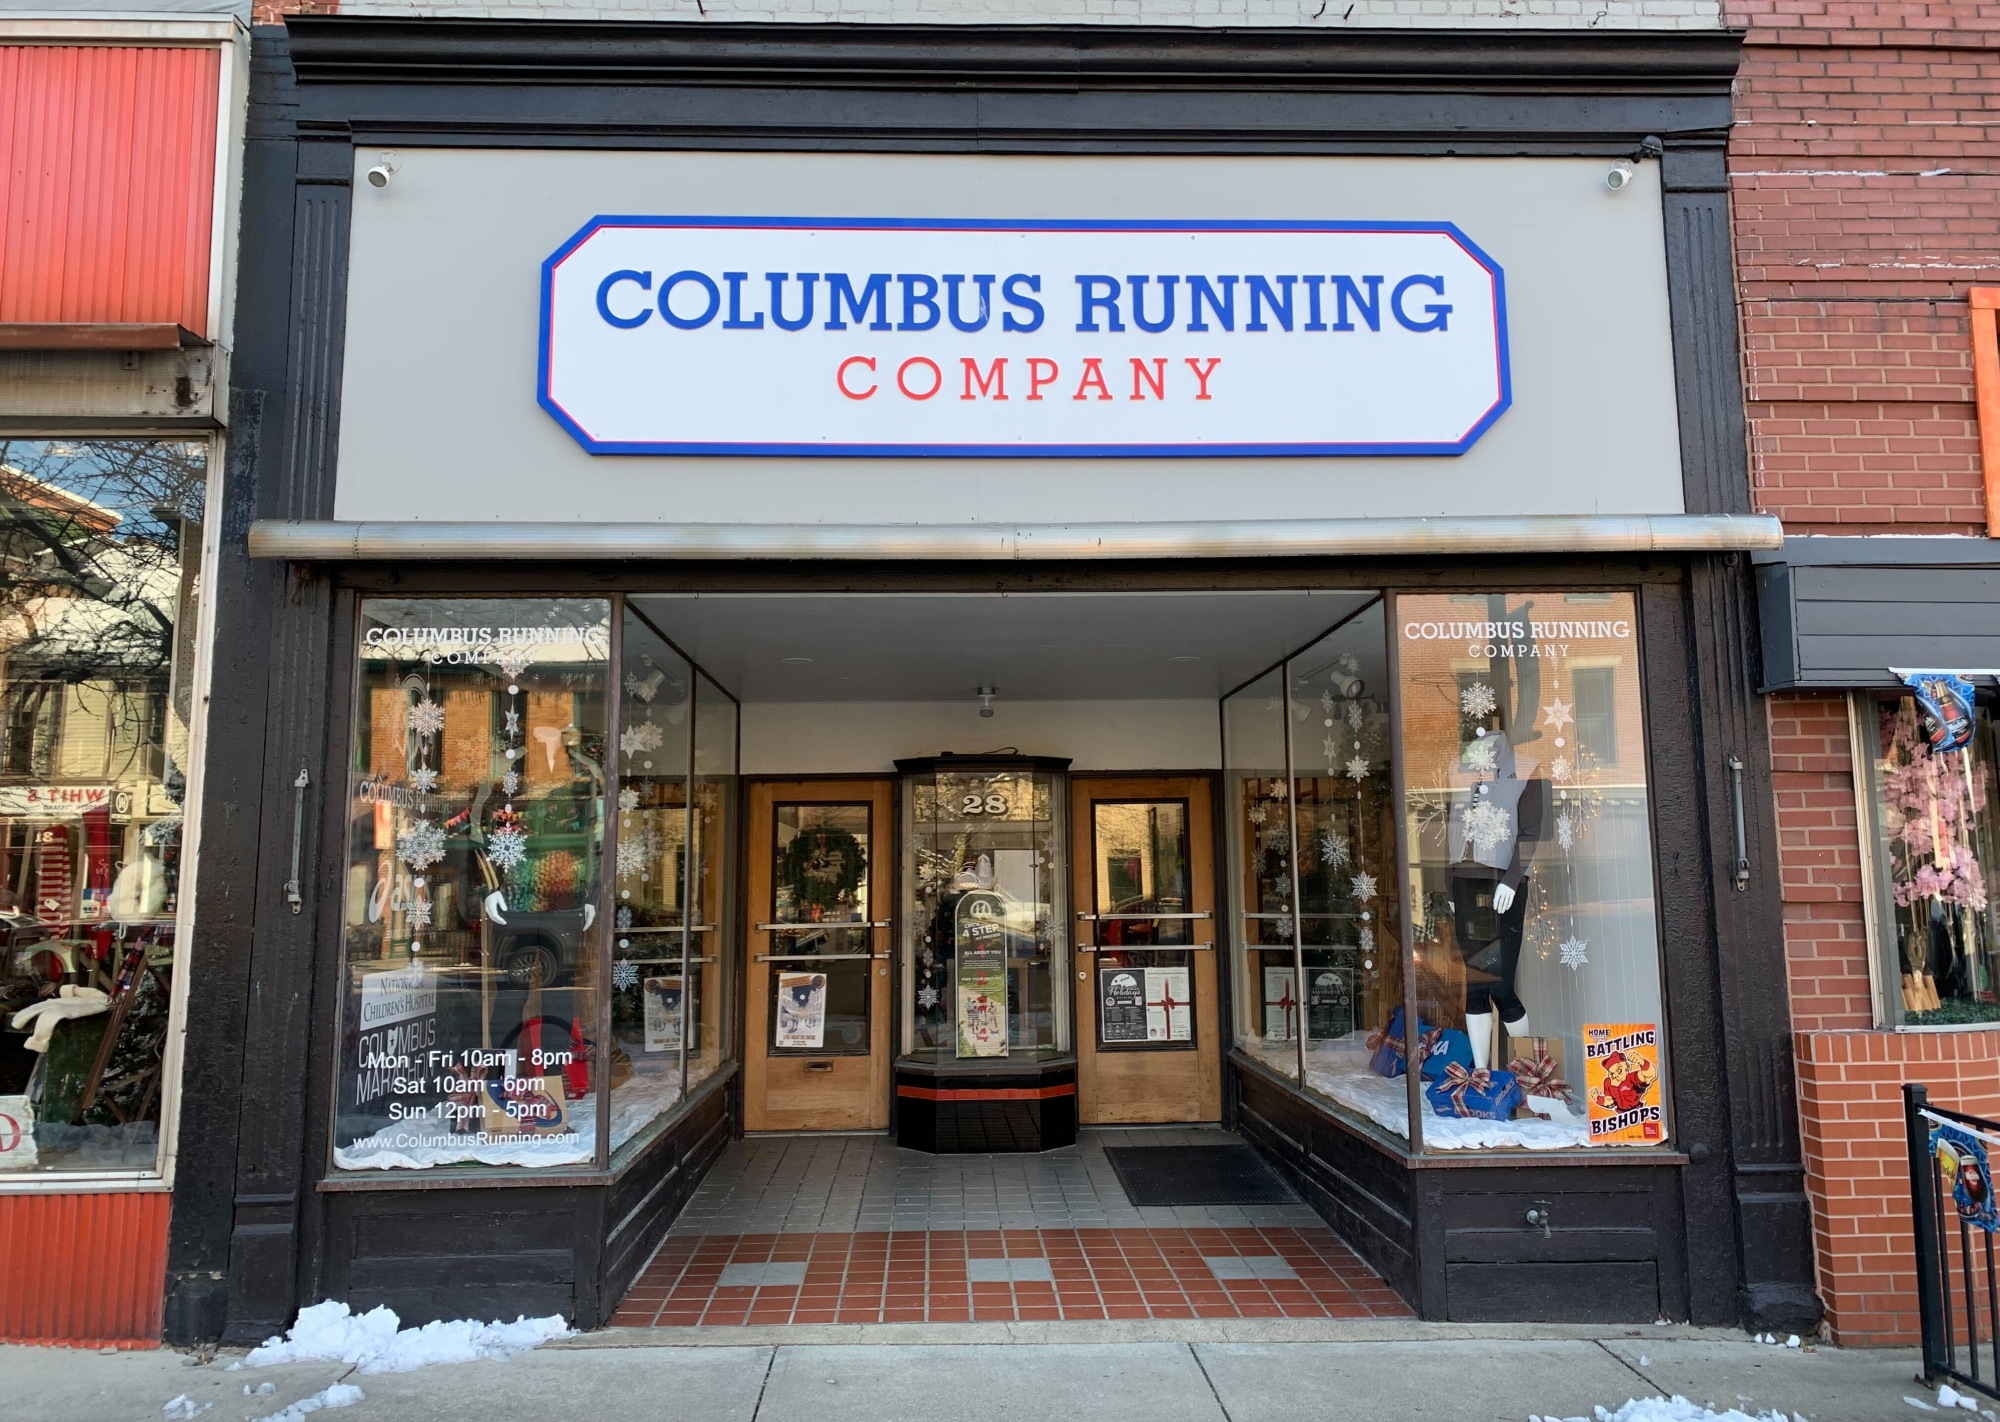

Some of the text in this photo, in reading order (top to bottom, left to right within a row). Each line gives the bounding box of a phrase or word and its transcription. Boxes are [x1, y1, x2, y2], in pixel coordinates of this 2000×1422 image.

[596, 269, 1453, 333] COLUMBUS RUNNING
[836, 355, 1221, 401] COMPANY
[366, 626, 603, 646] COLUMBUS RUNNING
[1404, 620, 1631, 640] COLUMBUS RUNNING
[431, 651, 537, 665] COMPANY
[1468, 644, 1569, 658] COMPANY
[962, 794, 1007, 815] 28
[962, 923, 999, 938] 4 STEP
[405, 993, 435, 1013] HOSPITAL
[1588, 1028, 1611, 1036] HOME
[1586, 1030, 1656, 1058] BATTLING
[367, 1052, 408, 1069] Mon
[428, 1049, 453, 1068] Fri
[460, 1048, 512, 1067] 10am
[531, 1048, 573, 1069] 8pm
[393, 1077, 426, 1095] Sat
[432, 1075, 484, 1094] 10am
[503, 1074, 545, 1096] 6pm
[388, 1102, 426, 1120] Sun
[434, 1101, 486, 1123] 12pm
[505, 1100, 547, 1122] 5pm
[1454, 1108, 1495, 1119] BOOKS
[1591, 1108, 1660, 1135] BISHOPS
[352, 1131, 580, 1149] www.ColumbusRunning.com
